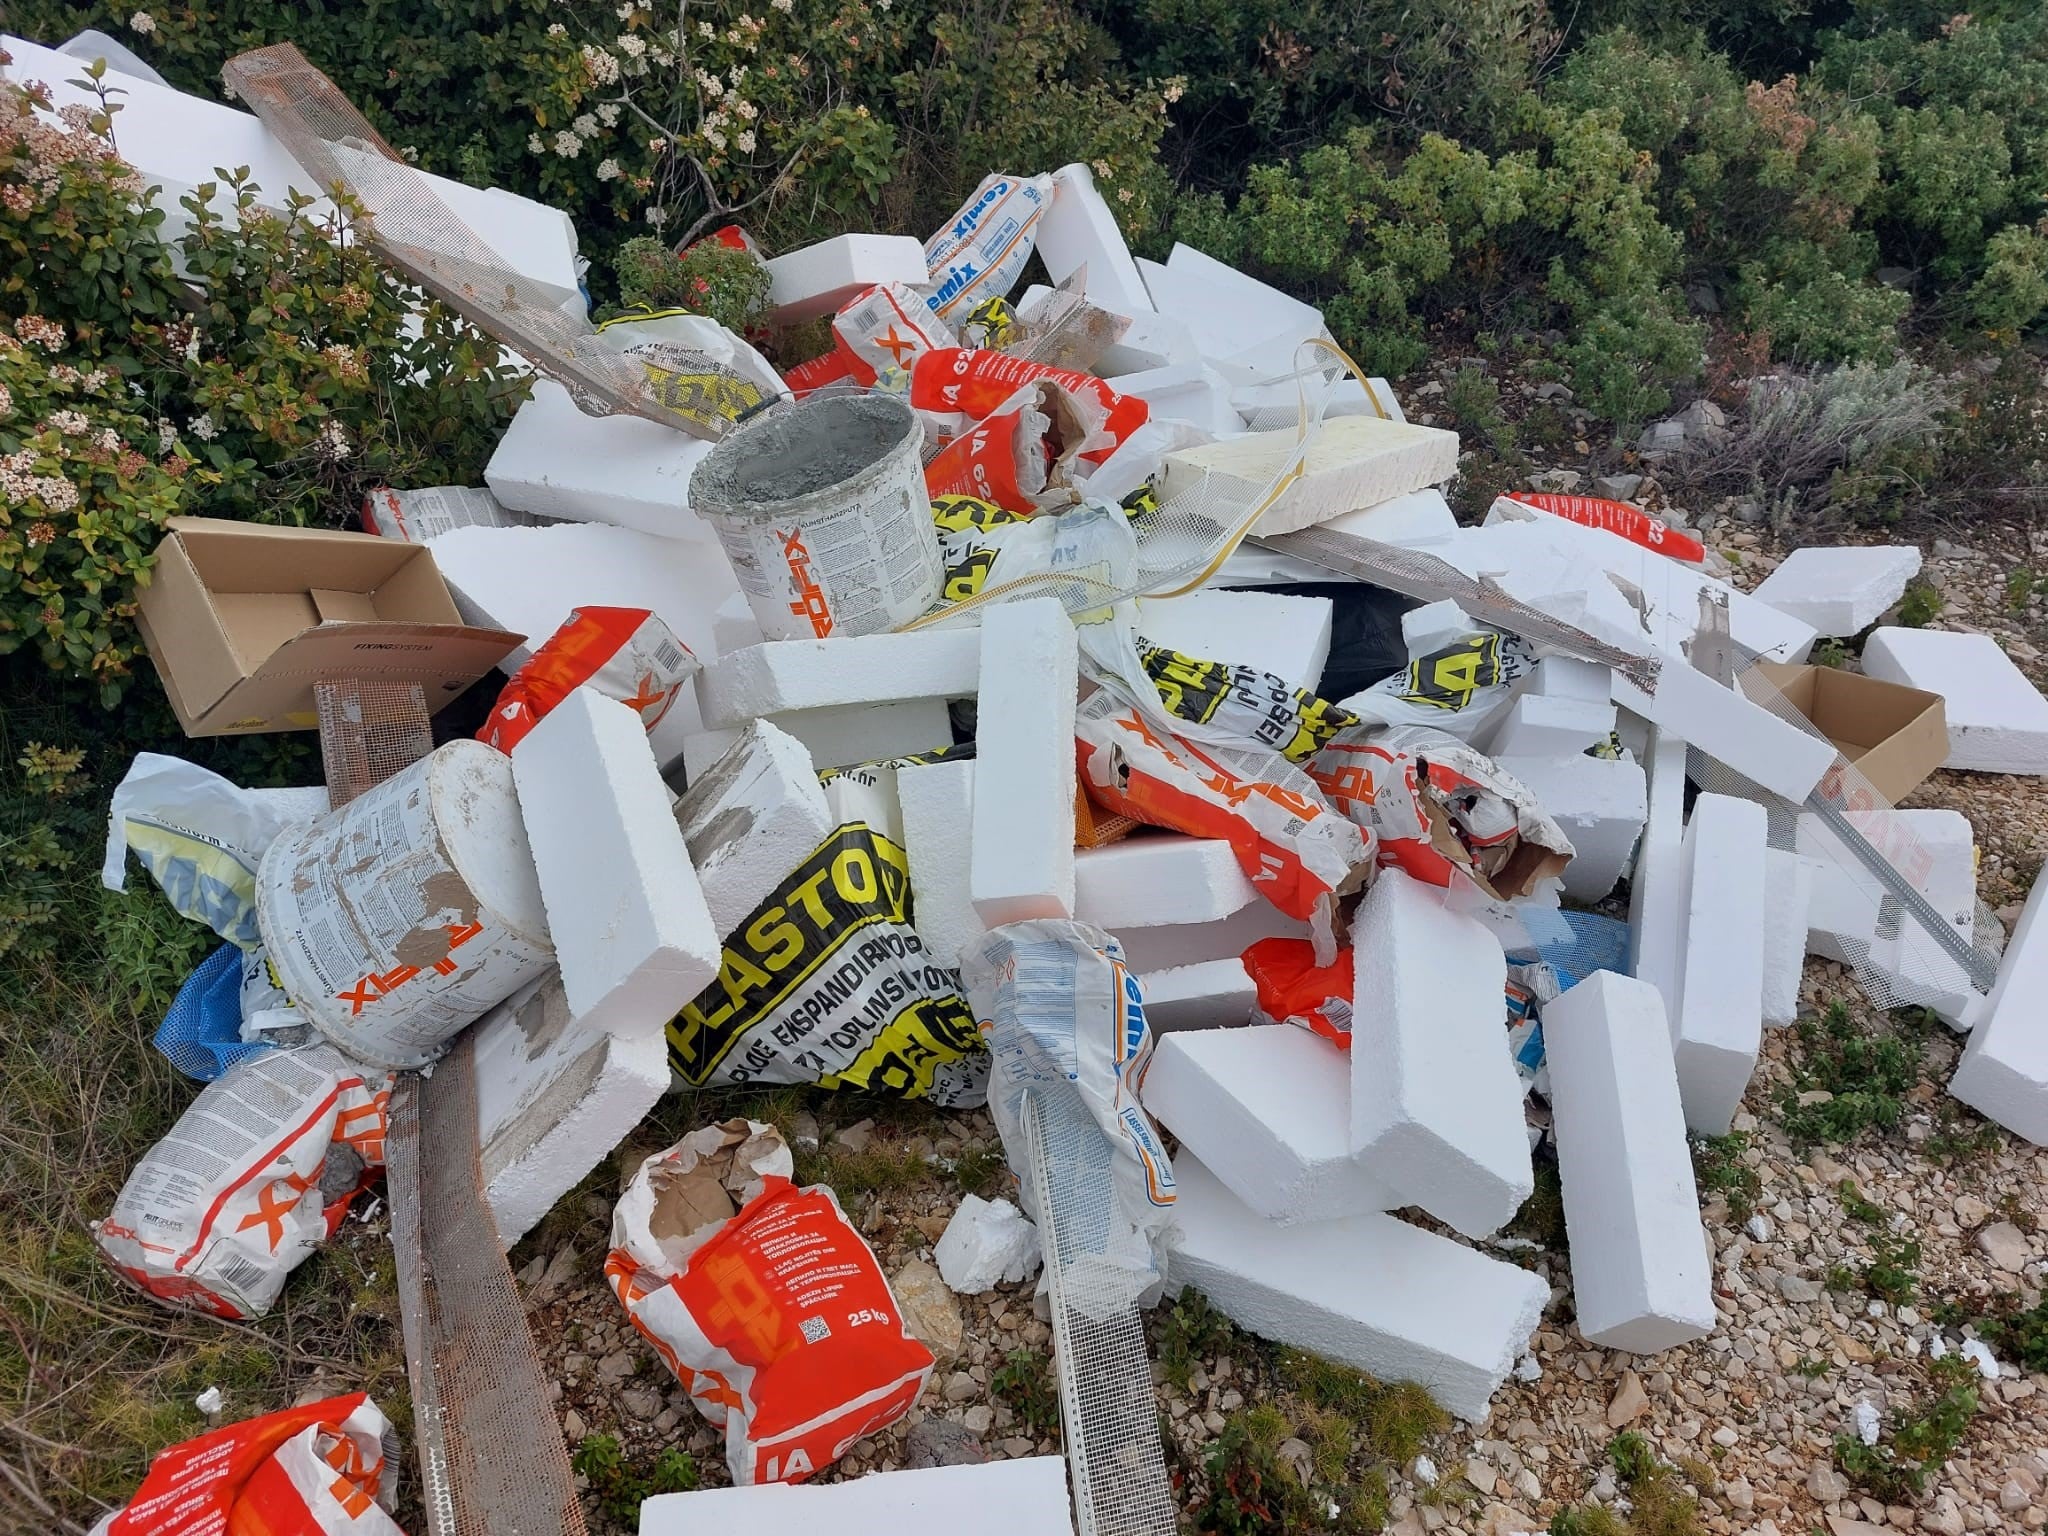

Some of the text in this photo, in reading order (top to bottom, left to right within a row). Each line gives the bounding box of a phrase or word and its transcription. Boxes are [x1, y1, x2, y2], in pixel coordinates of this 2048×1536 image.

[926, 262, 978, 311] emix
[970, 430, 999, 506] IA 62
[1252, 852, 1287, 882] IA
[294, 928, 337, 995] KUNSTHARZPUTZ
[664, 848, 880, 1065] PLASTO
[766, 1449, 815, 1481] IA
